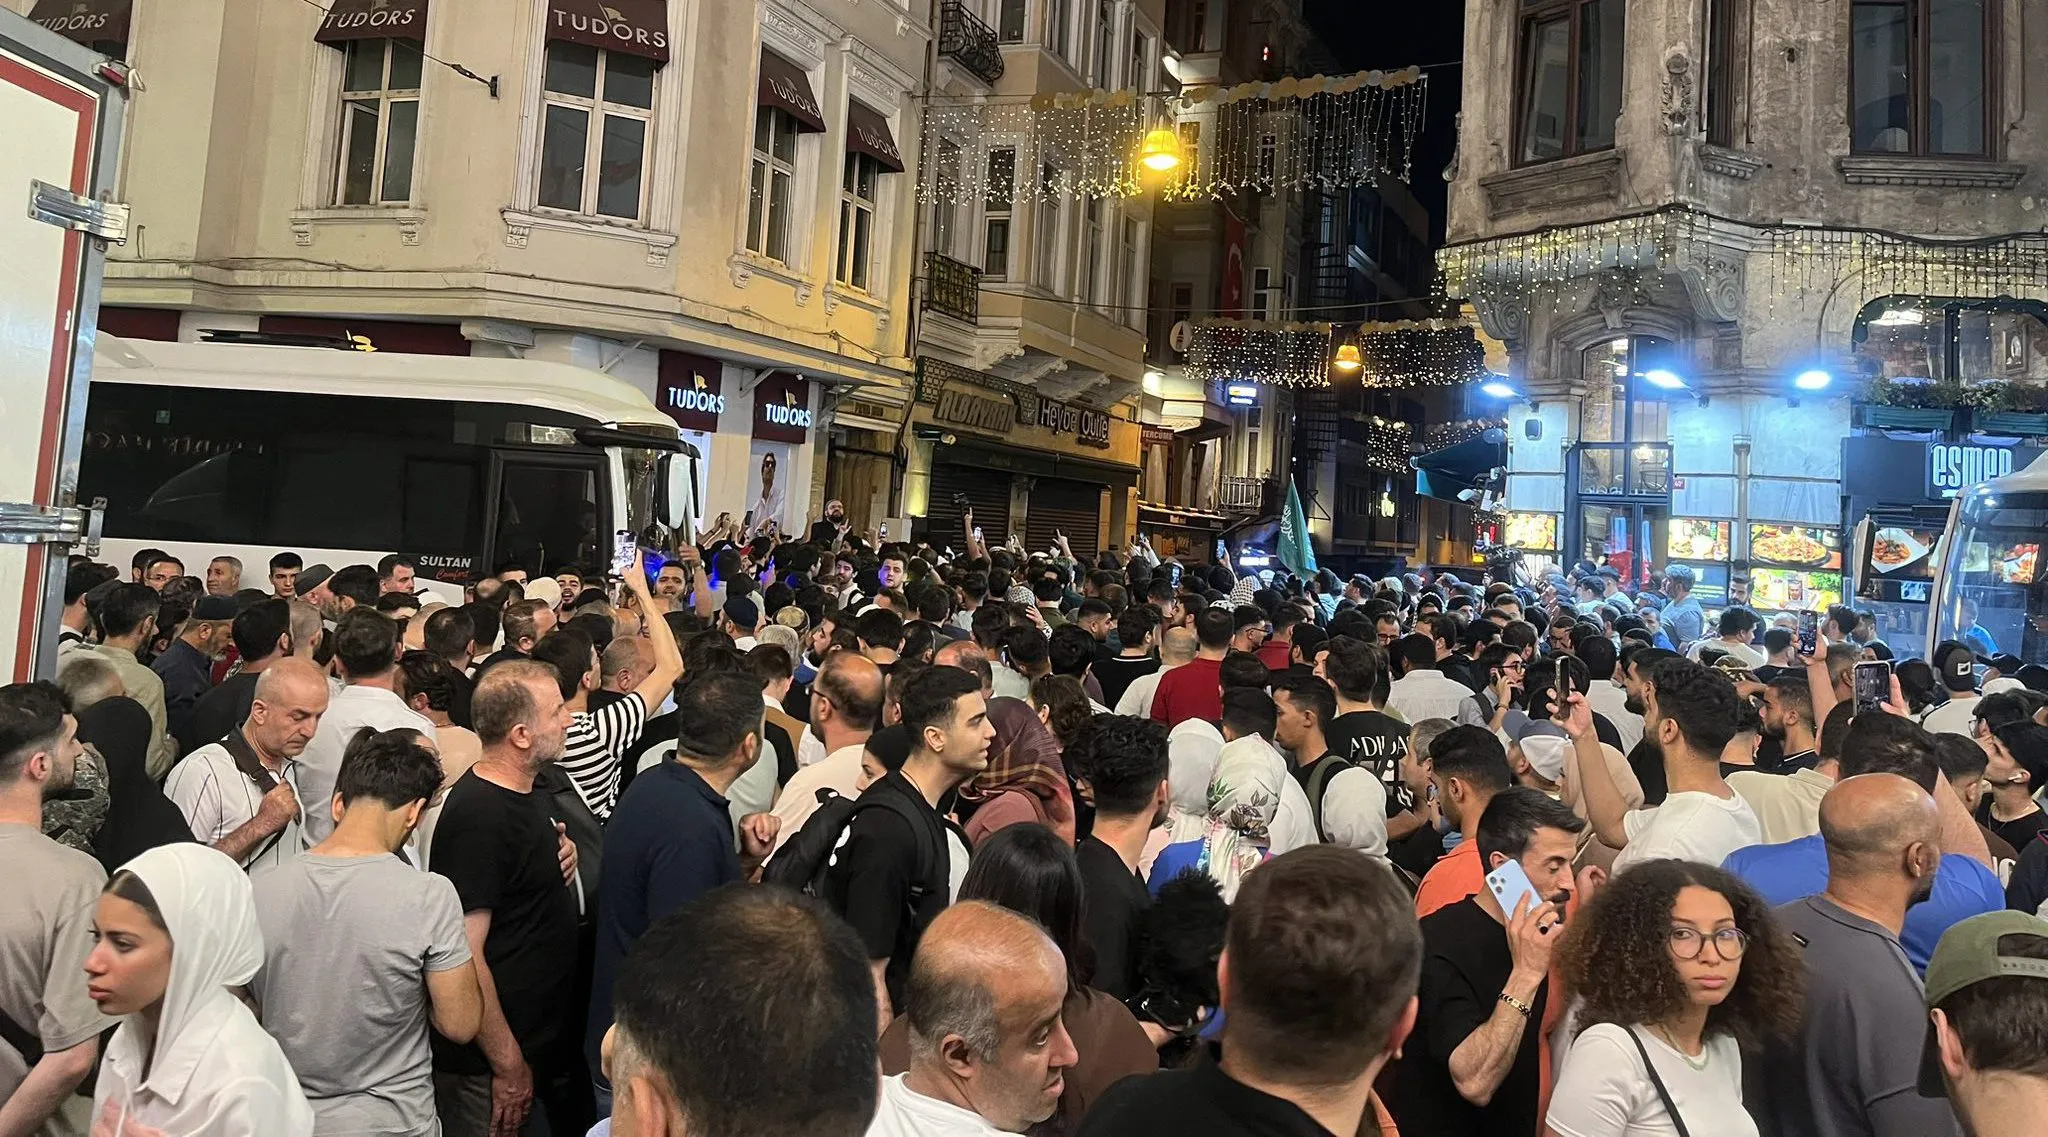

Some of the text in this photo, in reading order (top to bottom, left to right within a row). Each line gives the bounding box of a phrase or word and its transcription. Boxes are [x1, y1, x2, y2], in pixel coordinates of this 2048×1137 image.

[324, 8, 416, 29] TUDORS
[553, 9, 666, 48] TUDORS
[768, 77, 821, 119] TUDORS
[856, 126, 900, 160] TUDORS
[668, 386, 725, 415] TUDORS
[765, 403, 812, 428] TUDORS
[937, 390, 1019, 433] ALBAYRAK
[420, 555, 471, 568] SULTAN
